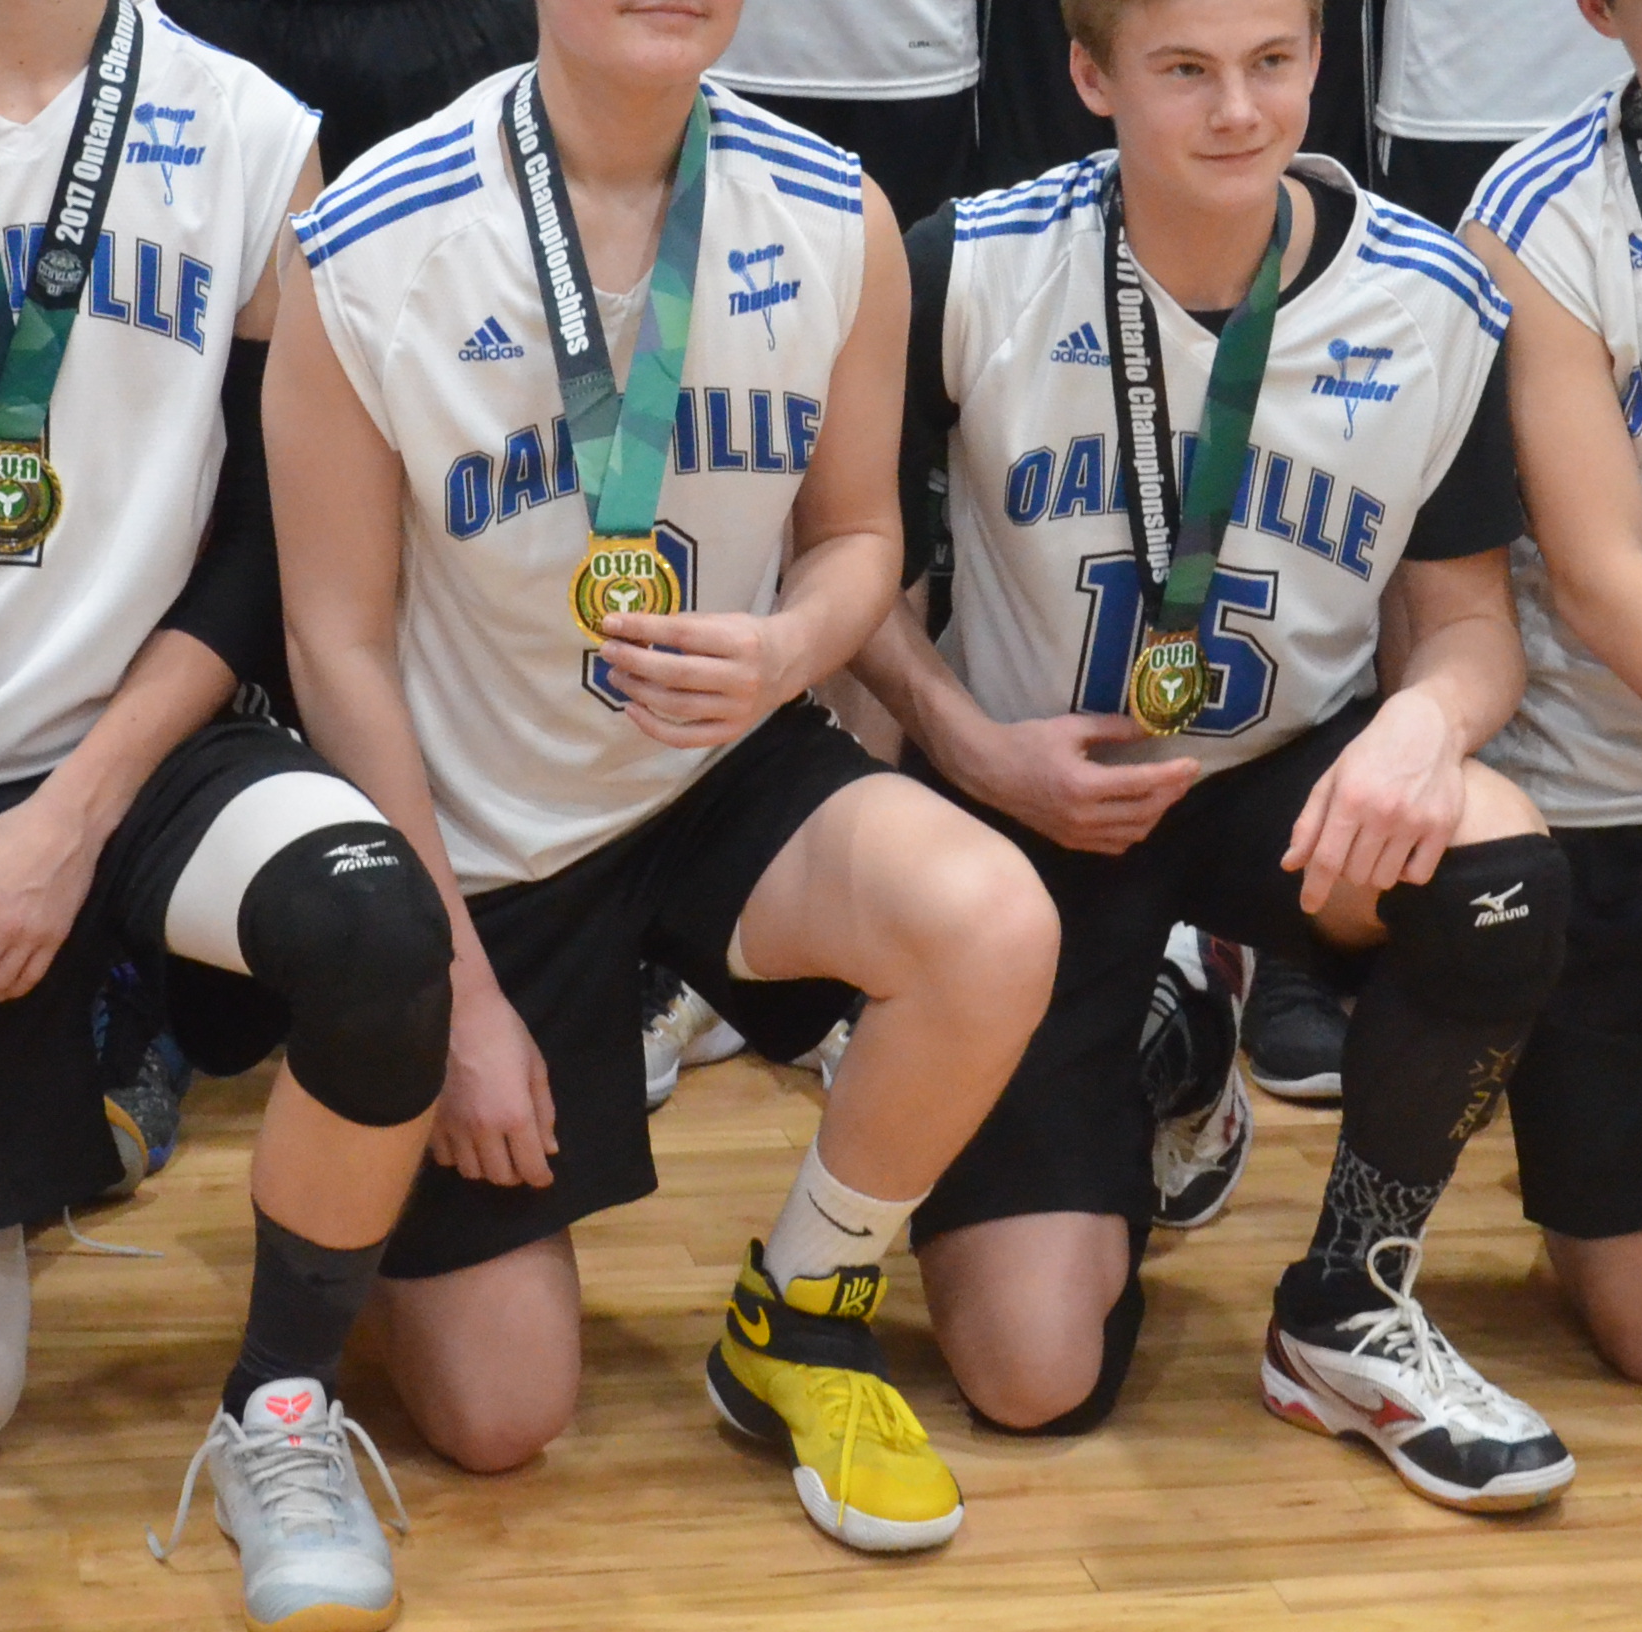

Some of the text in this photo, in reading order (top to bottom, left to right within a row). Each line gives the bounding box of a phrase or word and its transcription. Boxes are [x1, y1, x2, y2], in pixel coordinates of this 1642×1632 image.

[72, 86, 123, 184] Ontario
[126, 141, 204, 168] Thunder
[54, 180, 96, 246] 2017
[524, 151, 590, 357] Championships
[728, 278, 801, 317] Thunder
[458, 342, 524, 362] adidas
[1050, 348, 1110, 367] adidas
[1116, 287, 1150, 383] Ontario
[1310, 375, 1399, 403] Thunder
[444, 387, 821, 541] OAKILLE
[1127, 381, 1172, 586] Championships
[591, 551, 655, 579] OVA
[1069, 550, 1279, 739] 15
